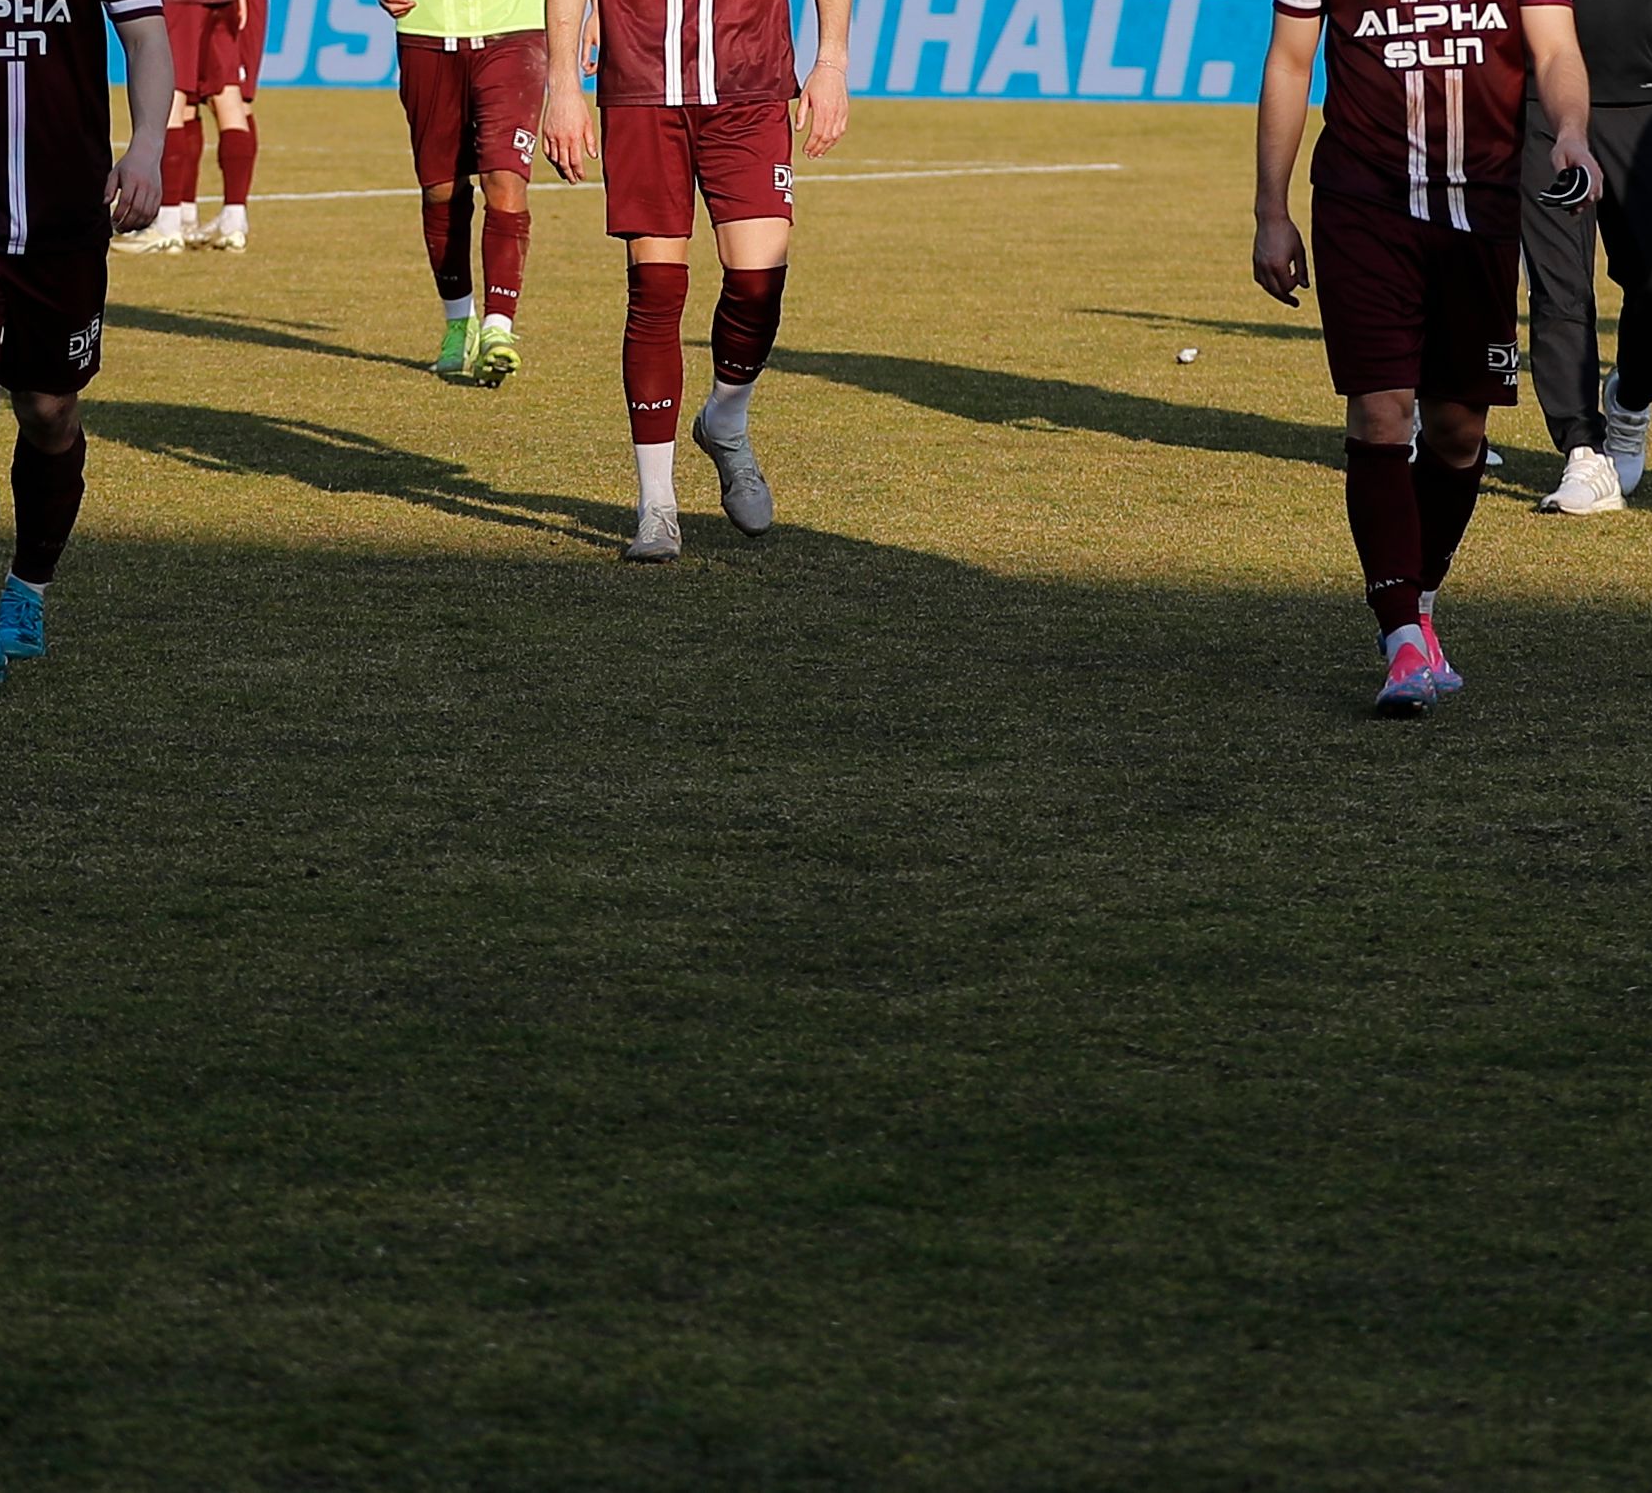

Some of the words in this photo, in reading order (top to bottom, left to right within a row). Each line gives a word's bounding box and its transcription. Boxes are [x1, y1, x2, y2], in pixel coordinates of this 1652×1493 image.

[1353, 2, 1508, 37] ALPHA
[1383, 37, 1484, 68] SUN
[489, 285, 518, 298] JAKO
